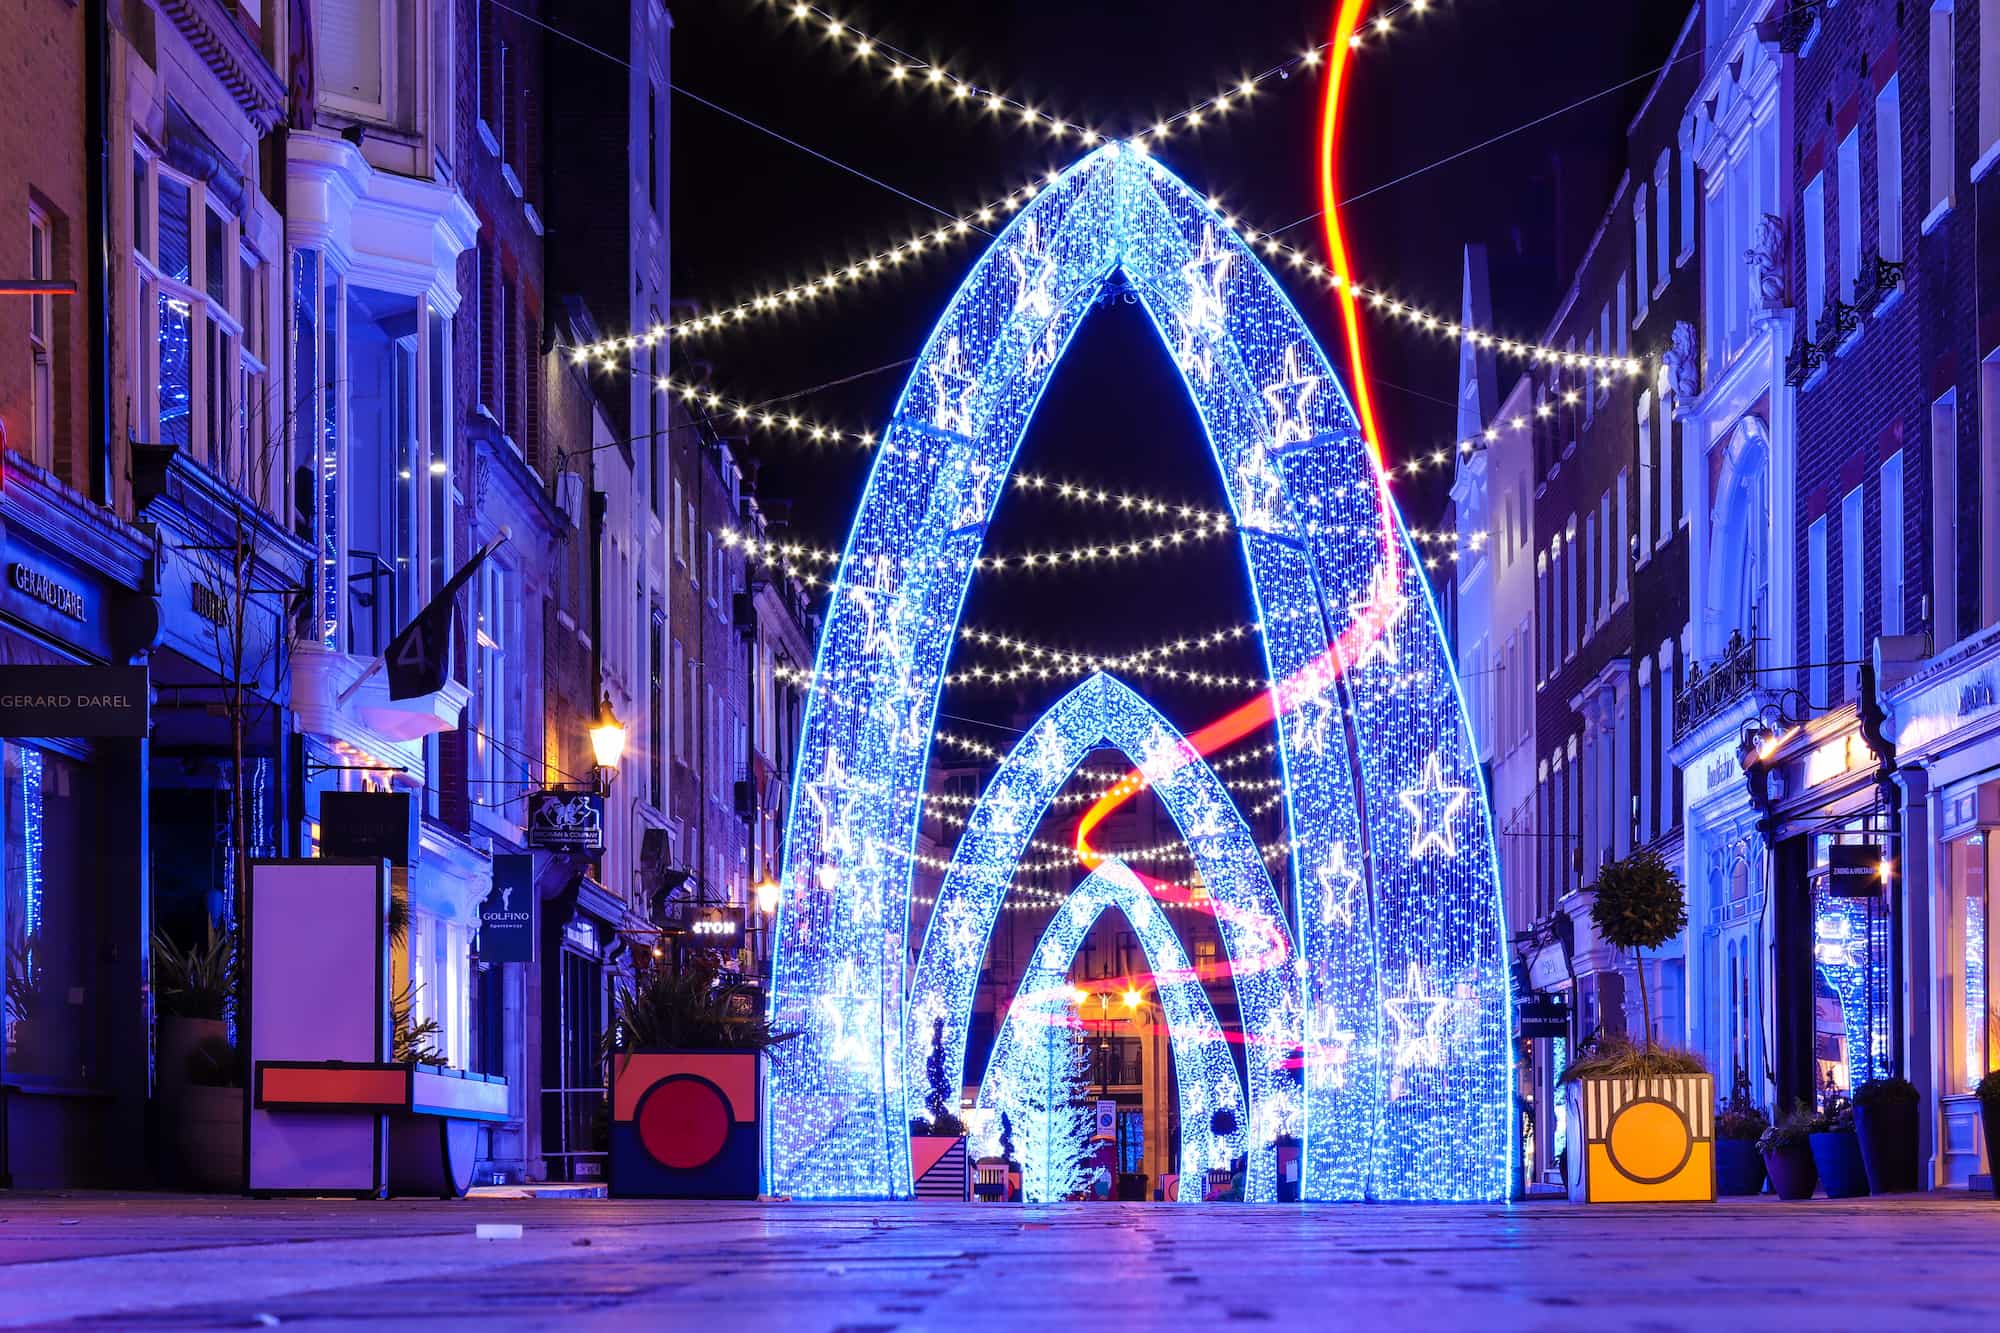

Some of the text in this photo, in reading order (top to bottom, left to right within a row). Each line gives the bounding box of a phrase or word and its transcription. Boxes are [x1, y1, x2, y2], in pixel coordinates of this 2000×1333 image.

[16, 563, 88, 623] GERARD DAREL
[1, 695, 132, 708] GERARD DAREL
[483, 912, 529, 921] GOLFINO
